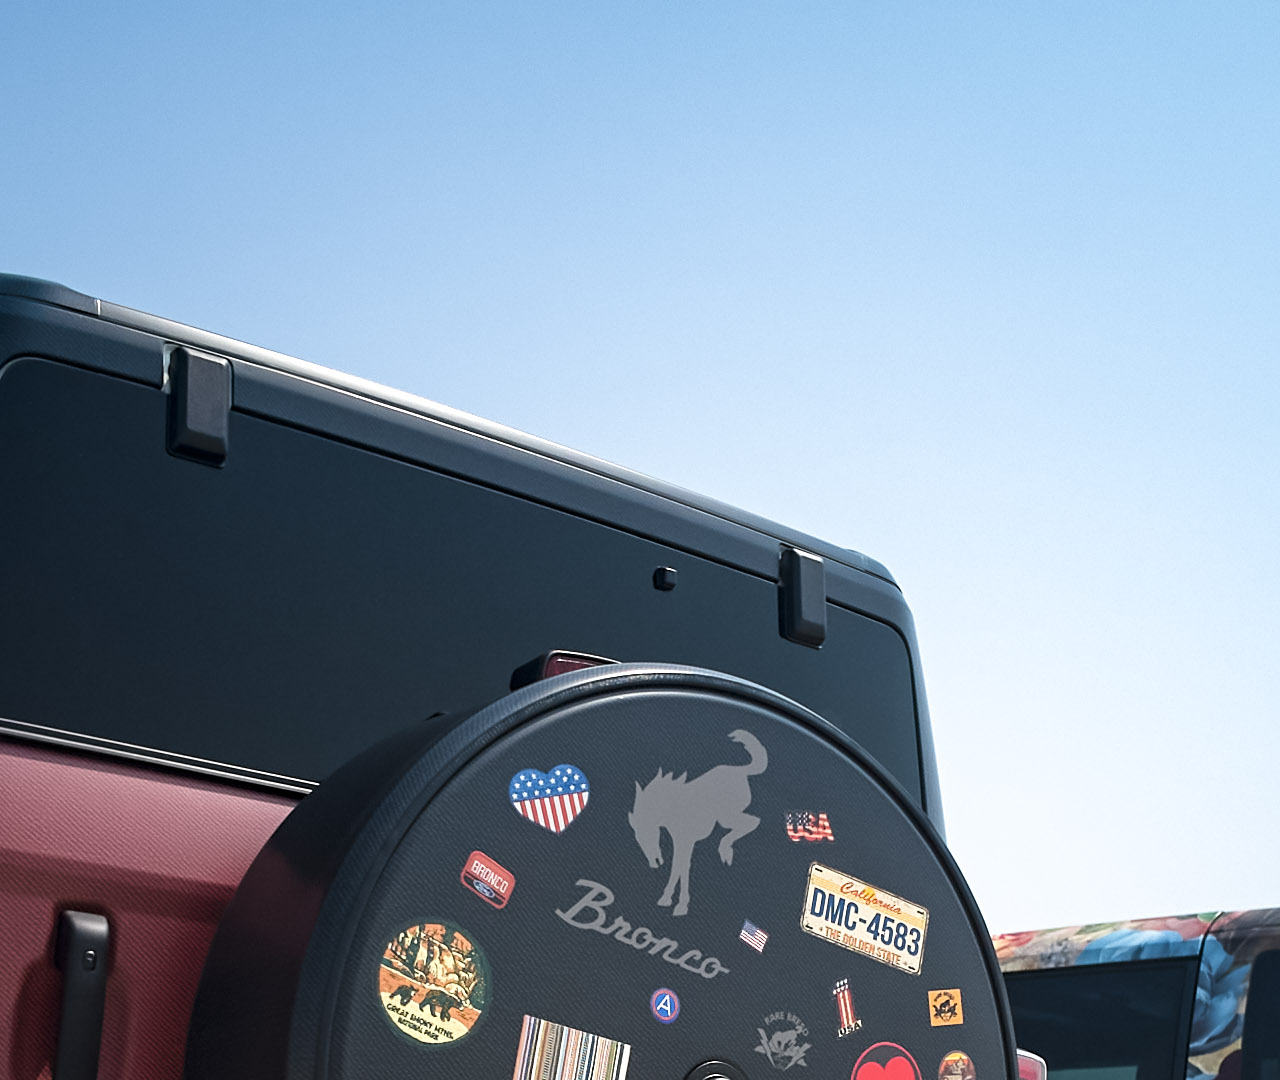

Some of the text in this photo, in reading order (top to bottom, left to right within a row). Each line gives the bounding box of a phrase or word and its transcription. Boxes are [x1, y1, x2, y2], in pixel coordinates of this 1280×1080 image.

[785, 811, 835, 842] USA
[471, 860, 509, 893] BRONCO
[839, 881, 903, 915] California
[554, 878, 730, 979] Bronco
[810, 887, 921, 956] DMC-4583
[824, 925, 902, 965] THE GOLDEN STATE
[656, 994, 671, 1017] A
[839, 1020, 862, 1037] USA
